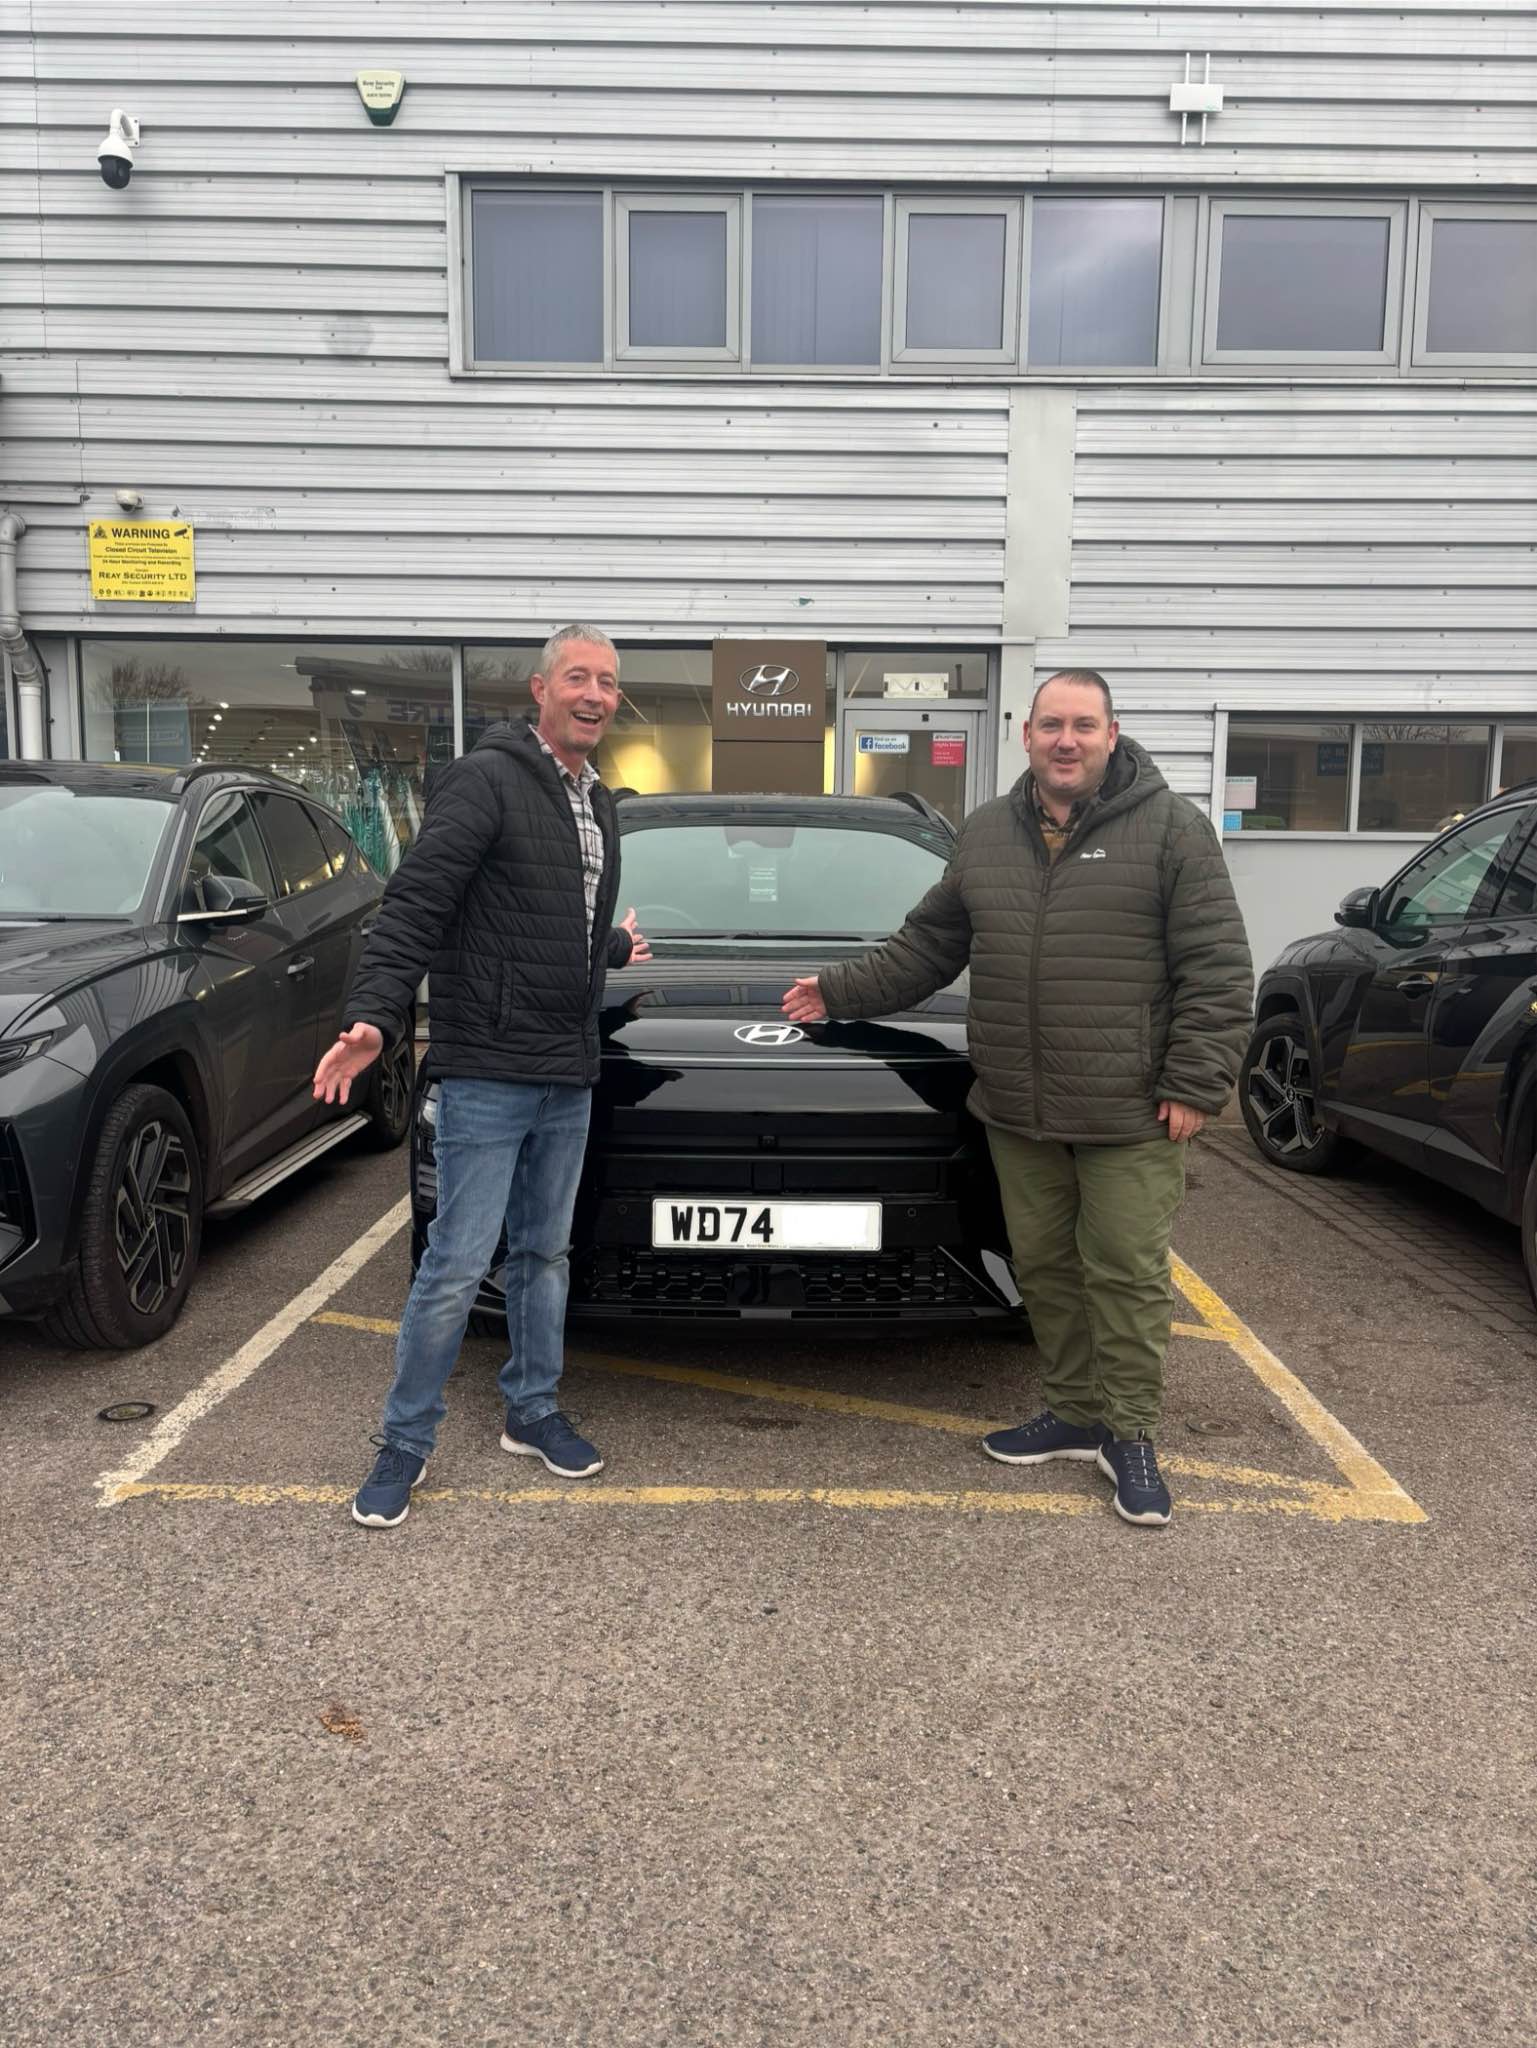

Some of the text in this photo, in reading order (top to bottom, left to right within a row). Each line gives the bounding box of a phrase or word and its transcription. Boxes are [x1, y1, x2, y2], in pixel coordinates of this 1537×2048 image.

[111, 528, 170, 539] WARNING
[98, 571, 188, 581] REAY SECURITY LTD
[726, 702, 812, 717] HYUNDAI
[875, 742, 906, 750] facebook
[671, 1205, 774, 1243] WD74
